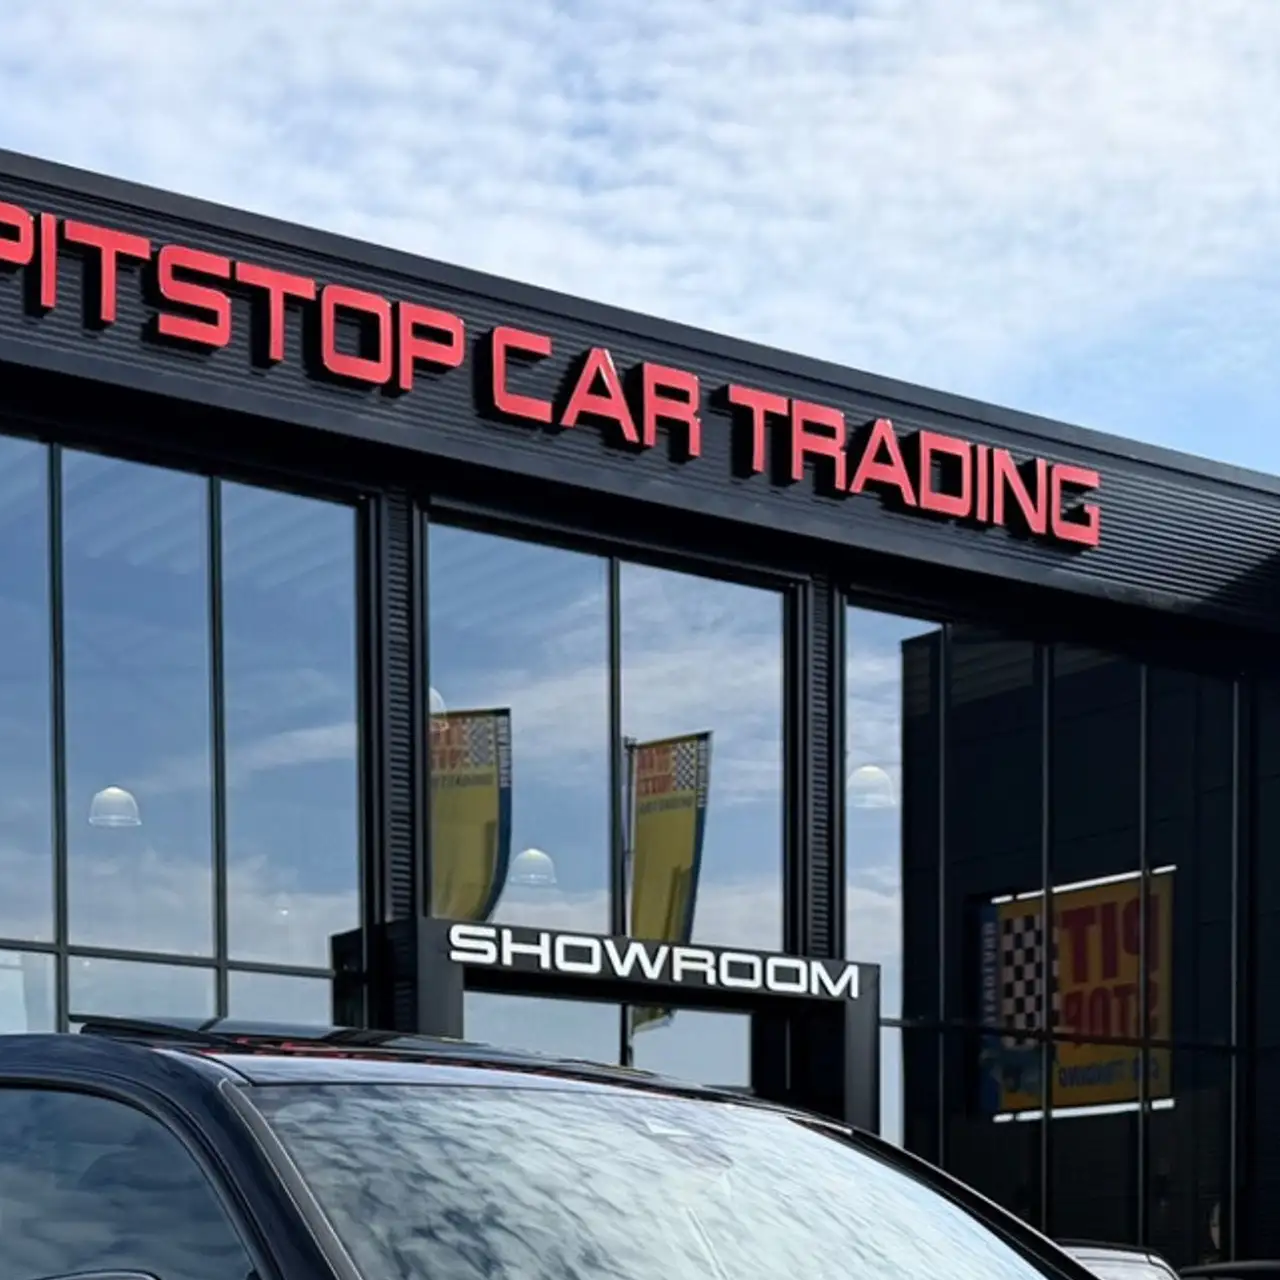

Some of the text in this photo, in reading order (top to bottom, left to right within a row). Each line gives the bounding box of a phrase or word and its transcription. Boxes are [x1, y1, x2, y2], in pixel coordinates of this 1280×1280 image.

[490, 326, 703, 460] CAR
[726, 382, 1103, 548] TRADING
[449, 924, 860, 998] SHOWROOM
